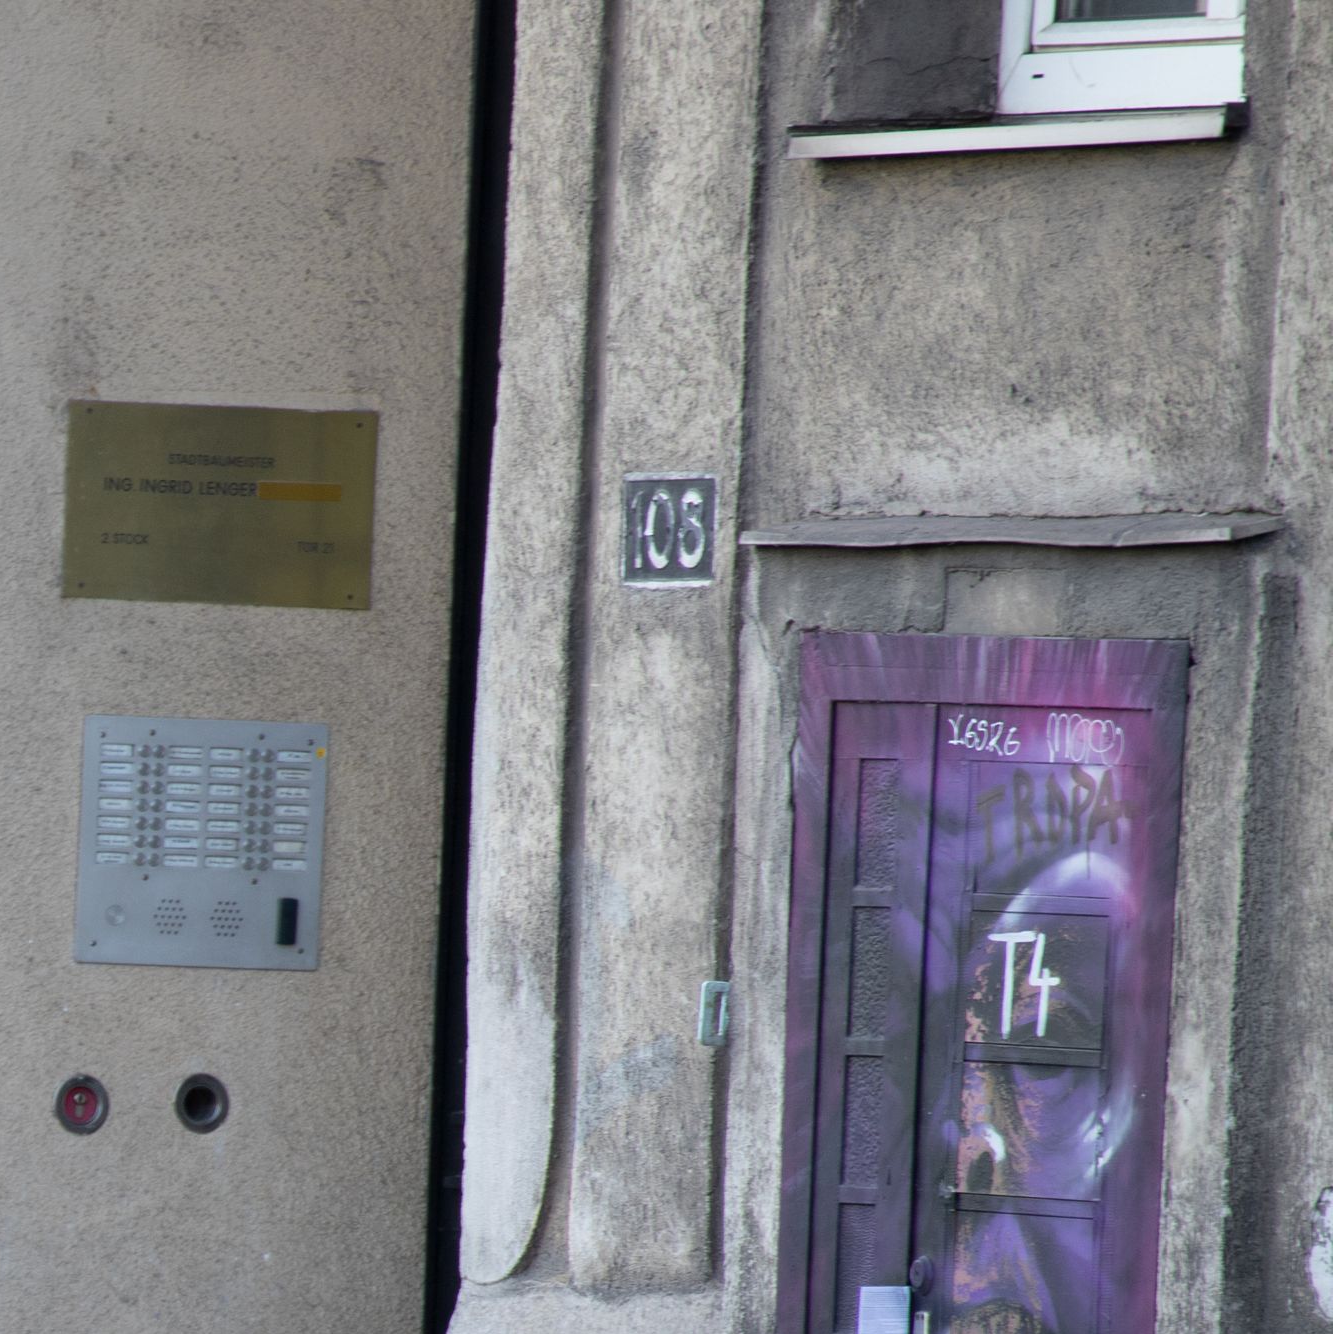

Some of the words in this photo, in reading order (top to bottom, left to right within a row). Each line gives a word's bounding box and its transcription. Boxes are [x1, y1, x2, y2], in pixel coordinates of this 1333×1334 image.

[139, 478, 193, 495] INGRID
[198, 480, 258, 497] LENGER
[631, 488, 706, 569] 108
